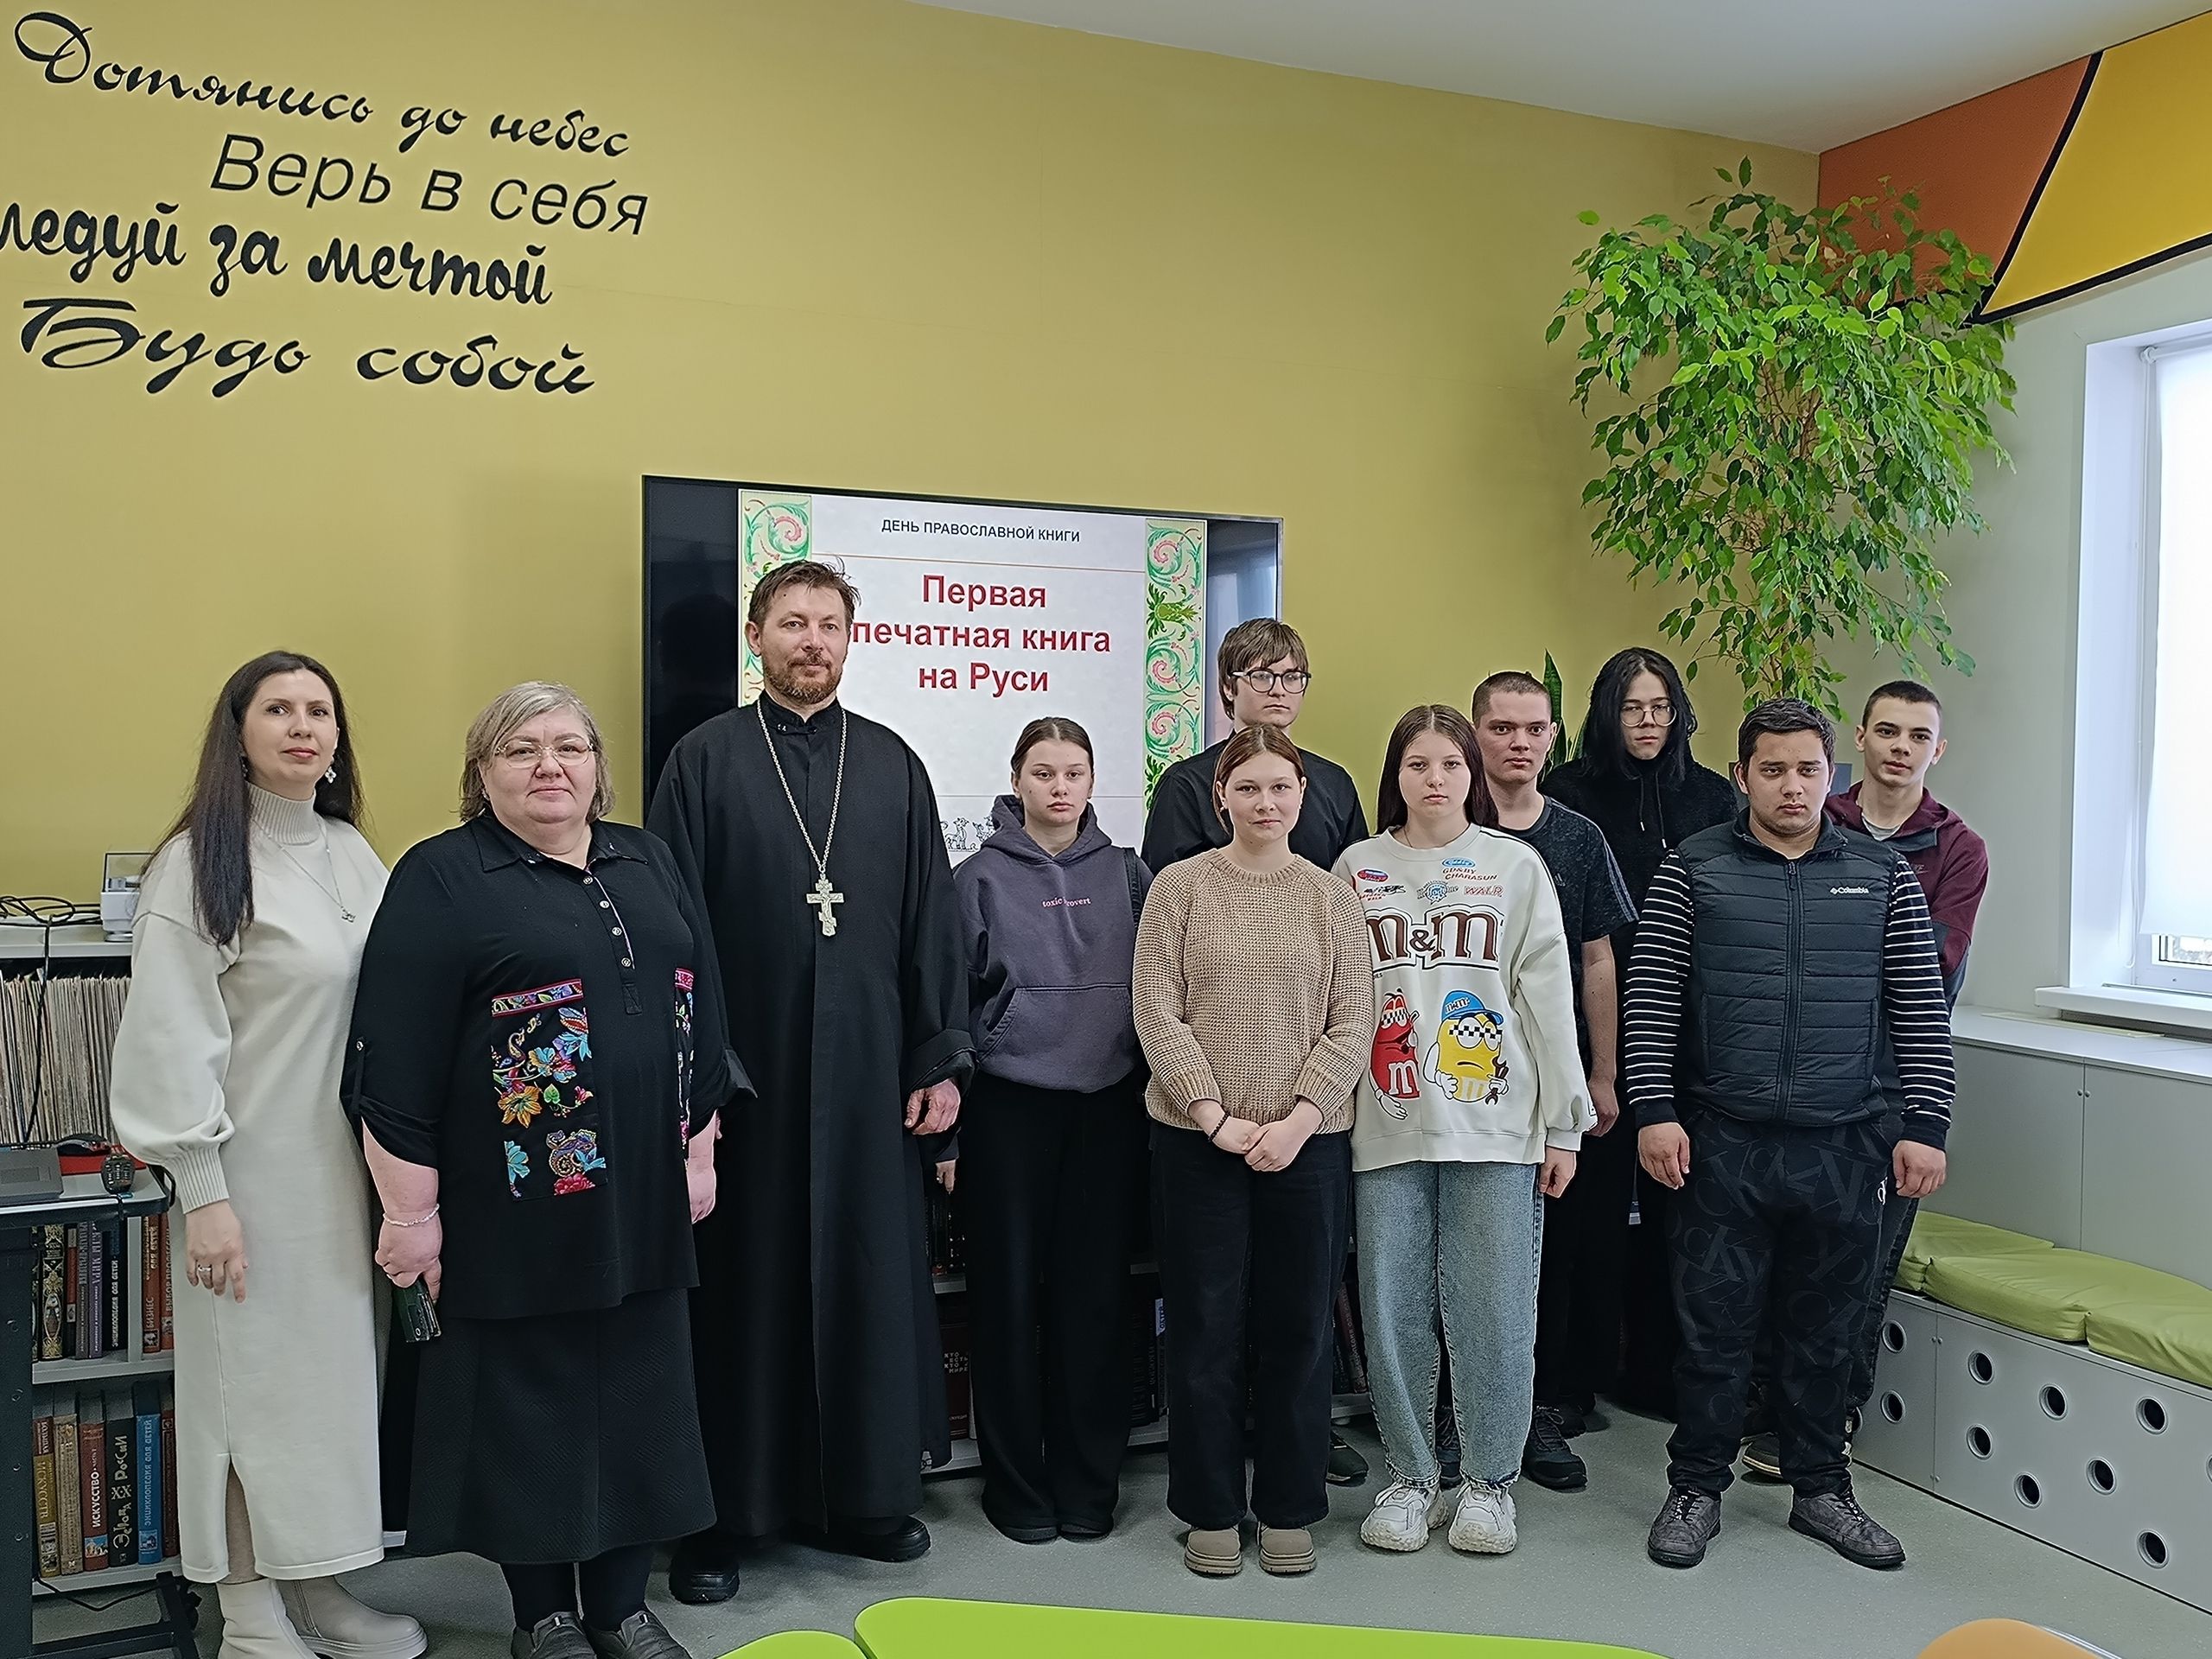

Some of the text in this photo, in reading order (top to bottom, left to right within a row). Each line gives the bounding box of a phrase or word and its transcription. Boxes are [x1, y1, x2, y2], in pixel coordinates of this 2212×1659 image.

[15, 12, 628, 156] Дотянись до небес
[211, 135, 647, 234] Верь в себя
[210, 225, 288, 296] за
[308, 238, 552, 304] мечтой
[22, 298, 594, 397] Будь собой
[881, 519, 1080, 542] ДЕНЬ ПРАВОСЛАВНОЙ КНИГИ
[923, 574, 1046, 612] Первая
[853, 621, 1110, 652] печатная книга
[918, 662, 1048, 698] на Руси
[1042, 897, 1063, 908] toxic
[91, 1471, 101, 1528] ИСКУССТВО
